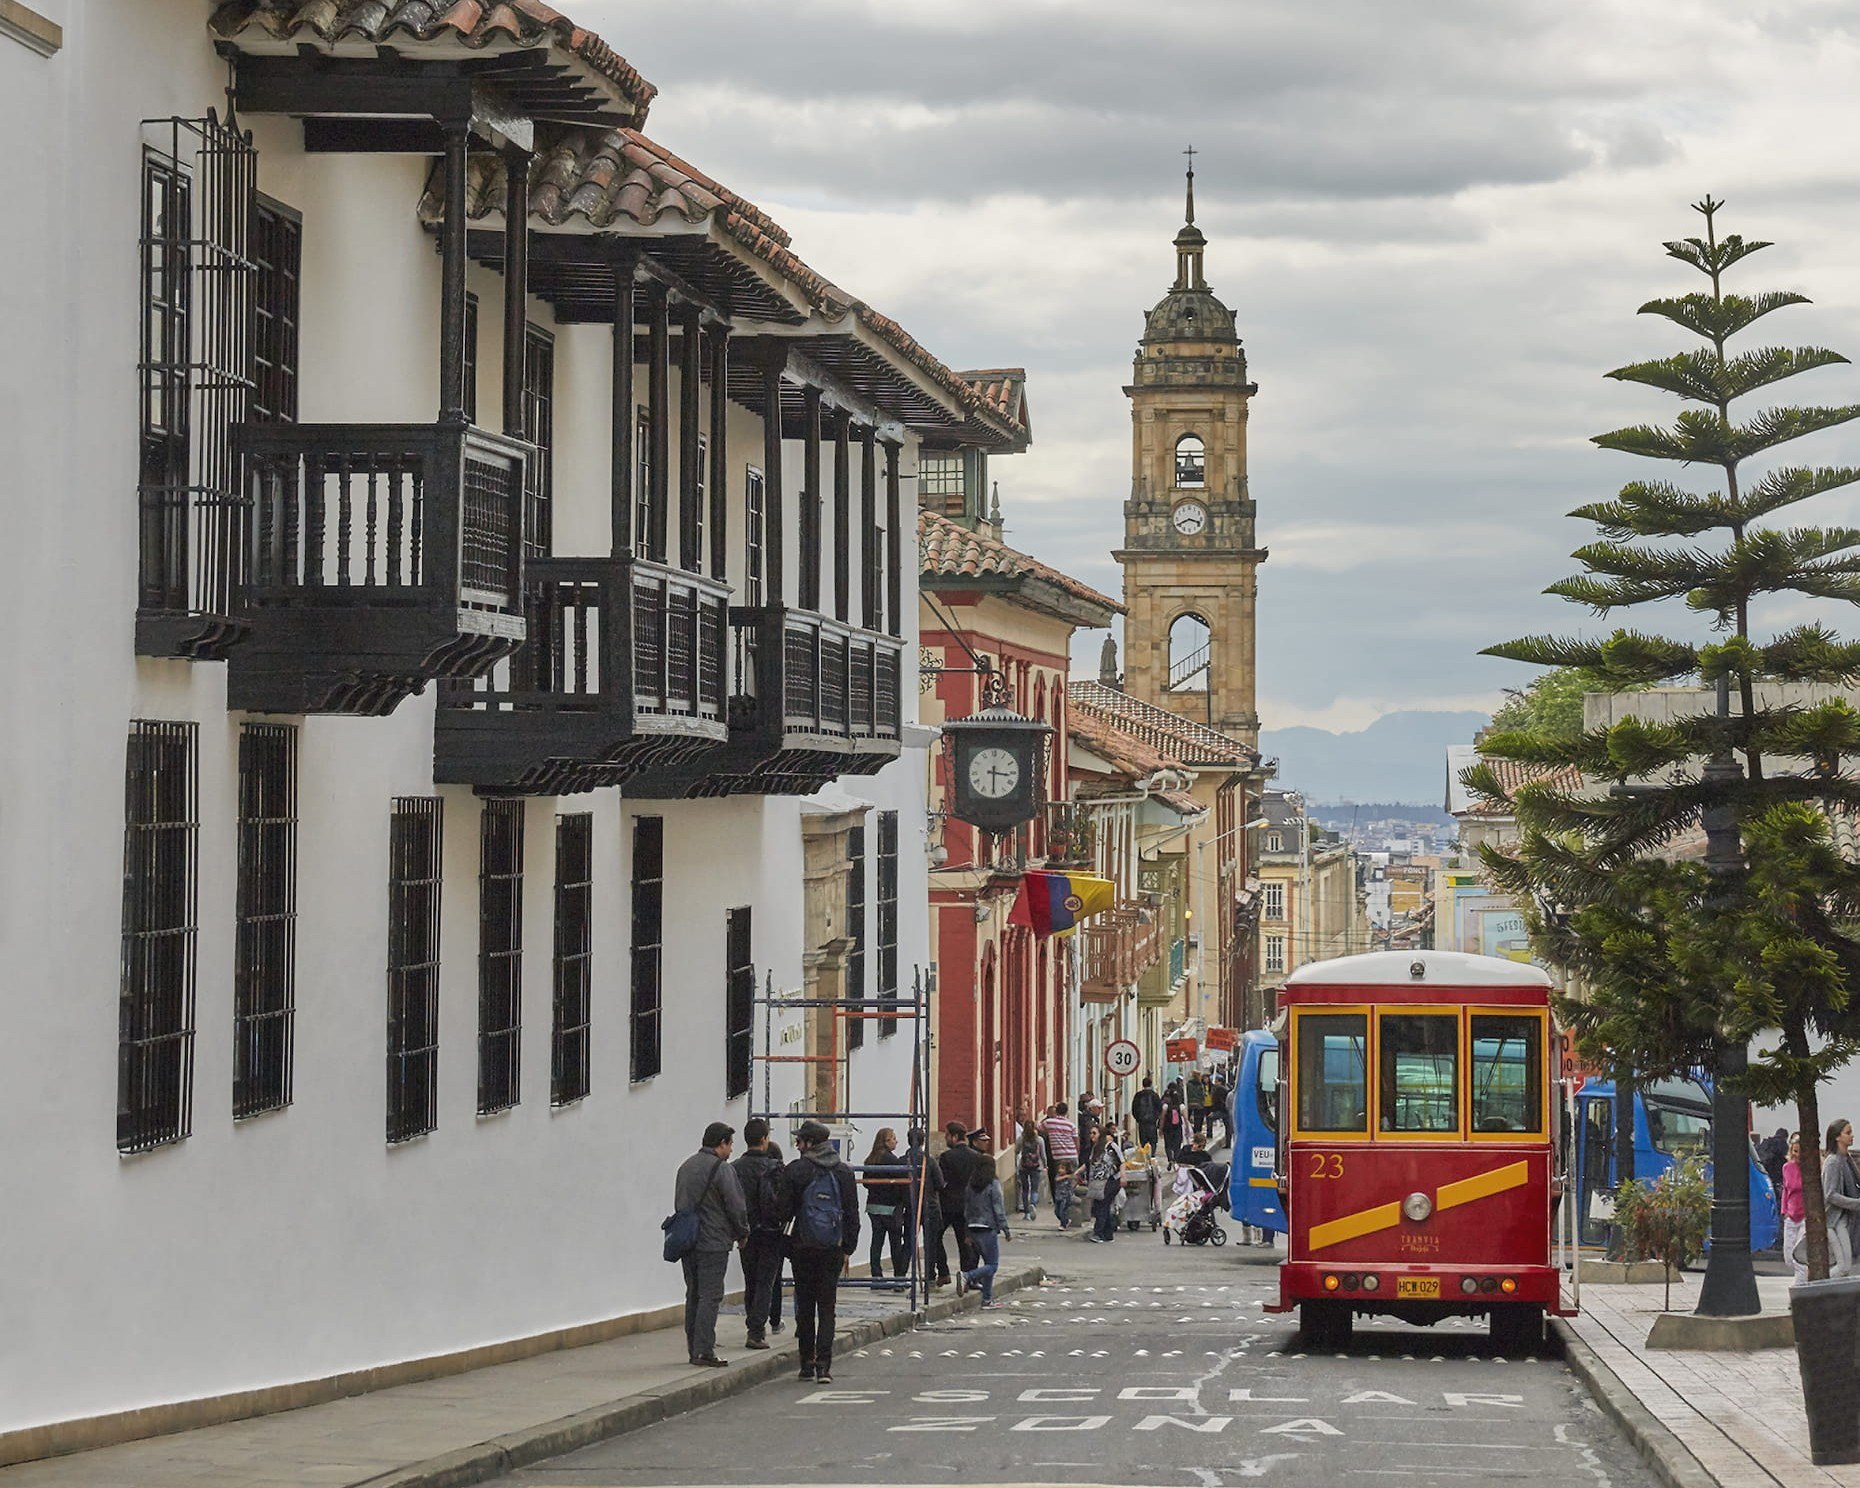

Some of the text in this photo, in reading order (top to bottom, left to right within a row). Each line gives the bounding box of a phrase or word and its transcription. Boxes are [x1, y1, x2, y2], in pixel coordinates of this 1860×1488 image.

[1115, 1051, 1132, 1066] 30
[1310, 1153, 1345, 1179] 23
[1398, 1281, 1438, 1293] HCW 029
[796, 1387, 1526, 1407] ESCOLAR
[886, 1414, 1345, 1436] ZONA
